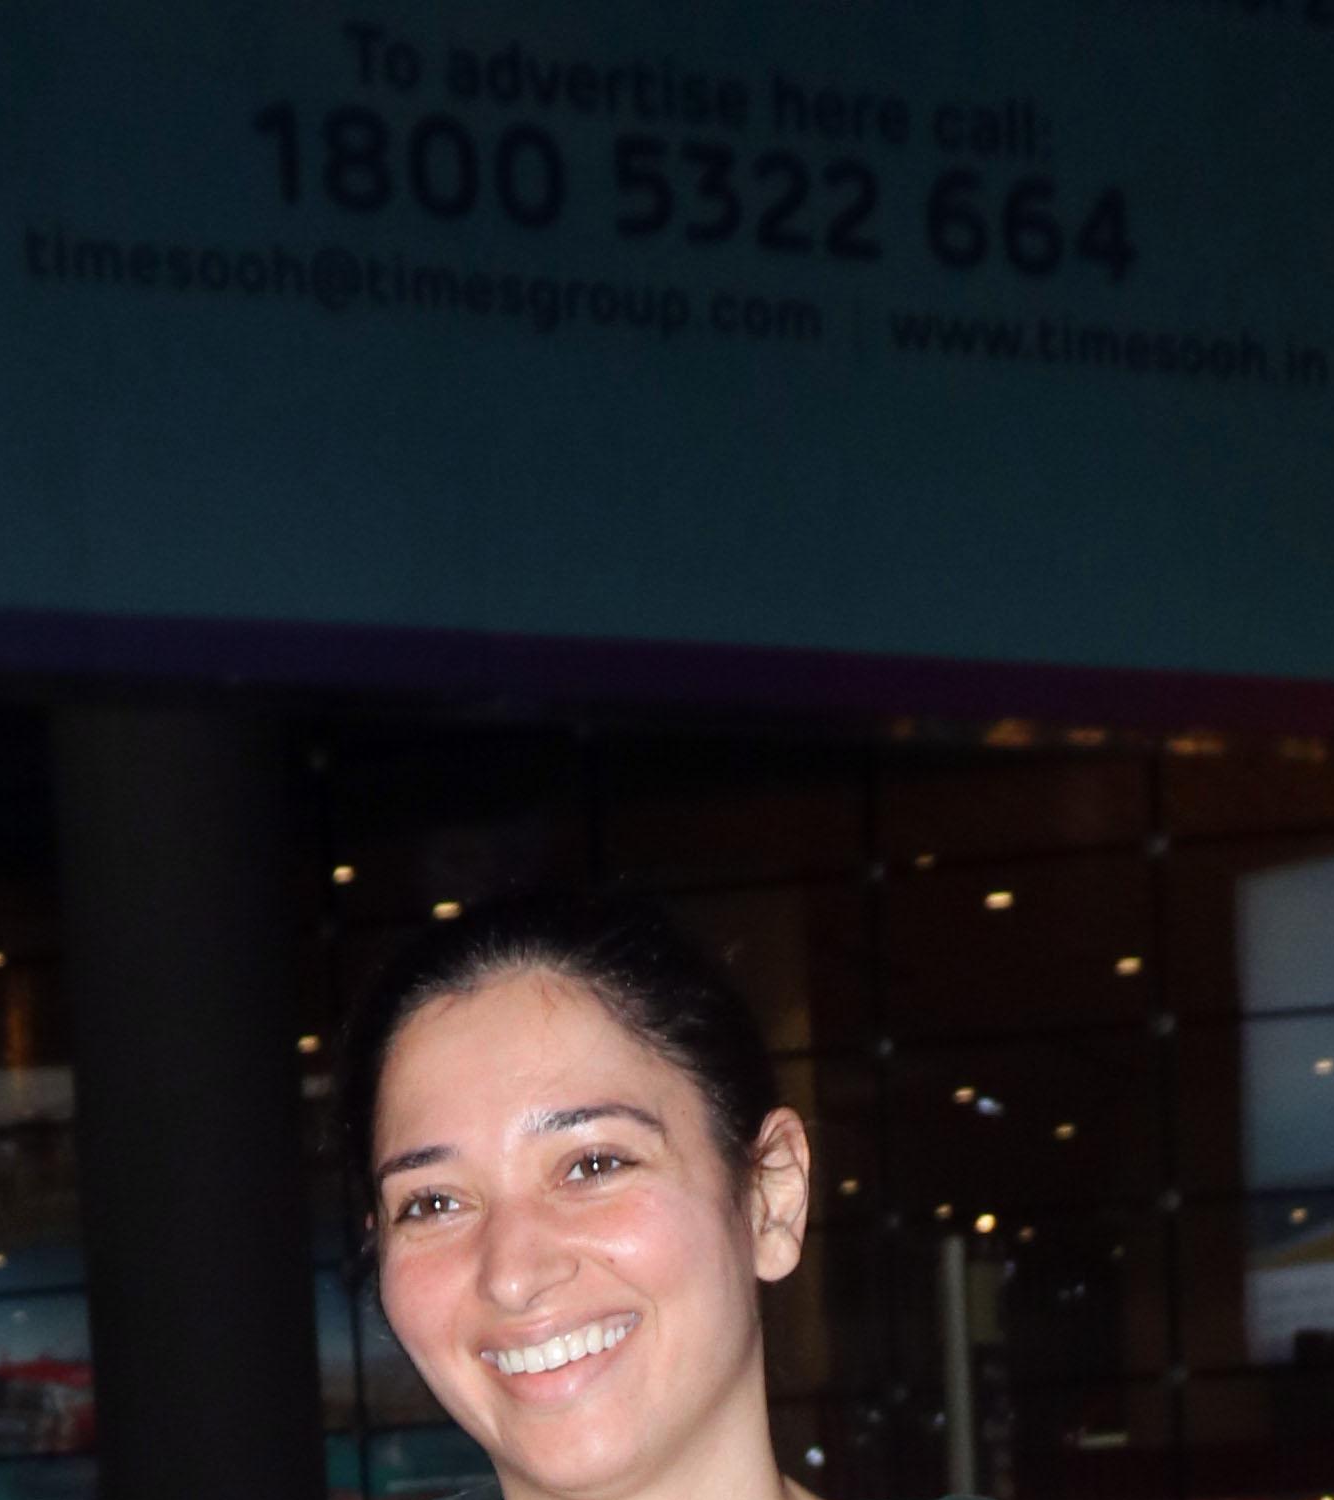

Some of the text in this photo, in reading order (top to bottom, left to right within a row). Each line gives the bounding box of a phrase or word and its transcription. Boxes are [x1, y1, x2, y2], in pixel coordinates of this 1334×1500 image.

[344, 20, 1053, 162] To advertise here call:
[252, 98, 1140, 287] 1800 5322 664
[22, 223, 1329, 387] timesooh@timesgroup.com www.timesooh.in
